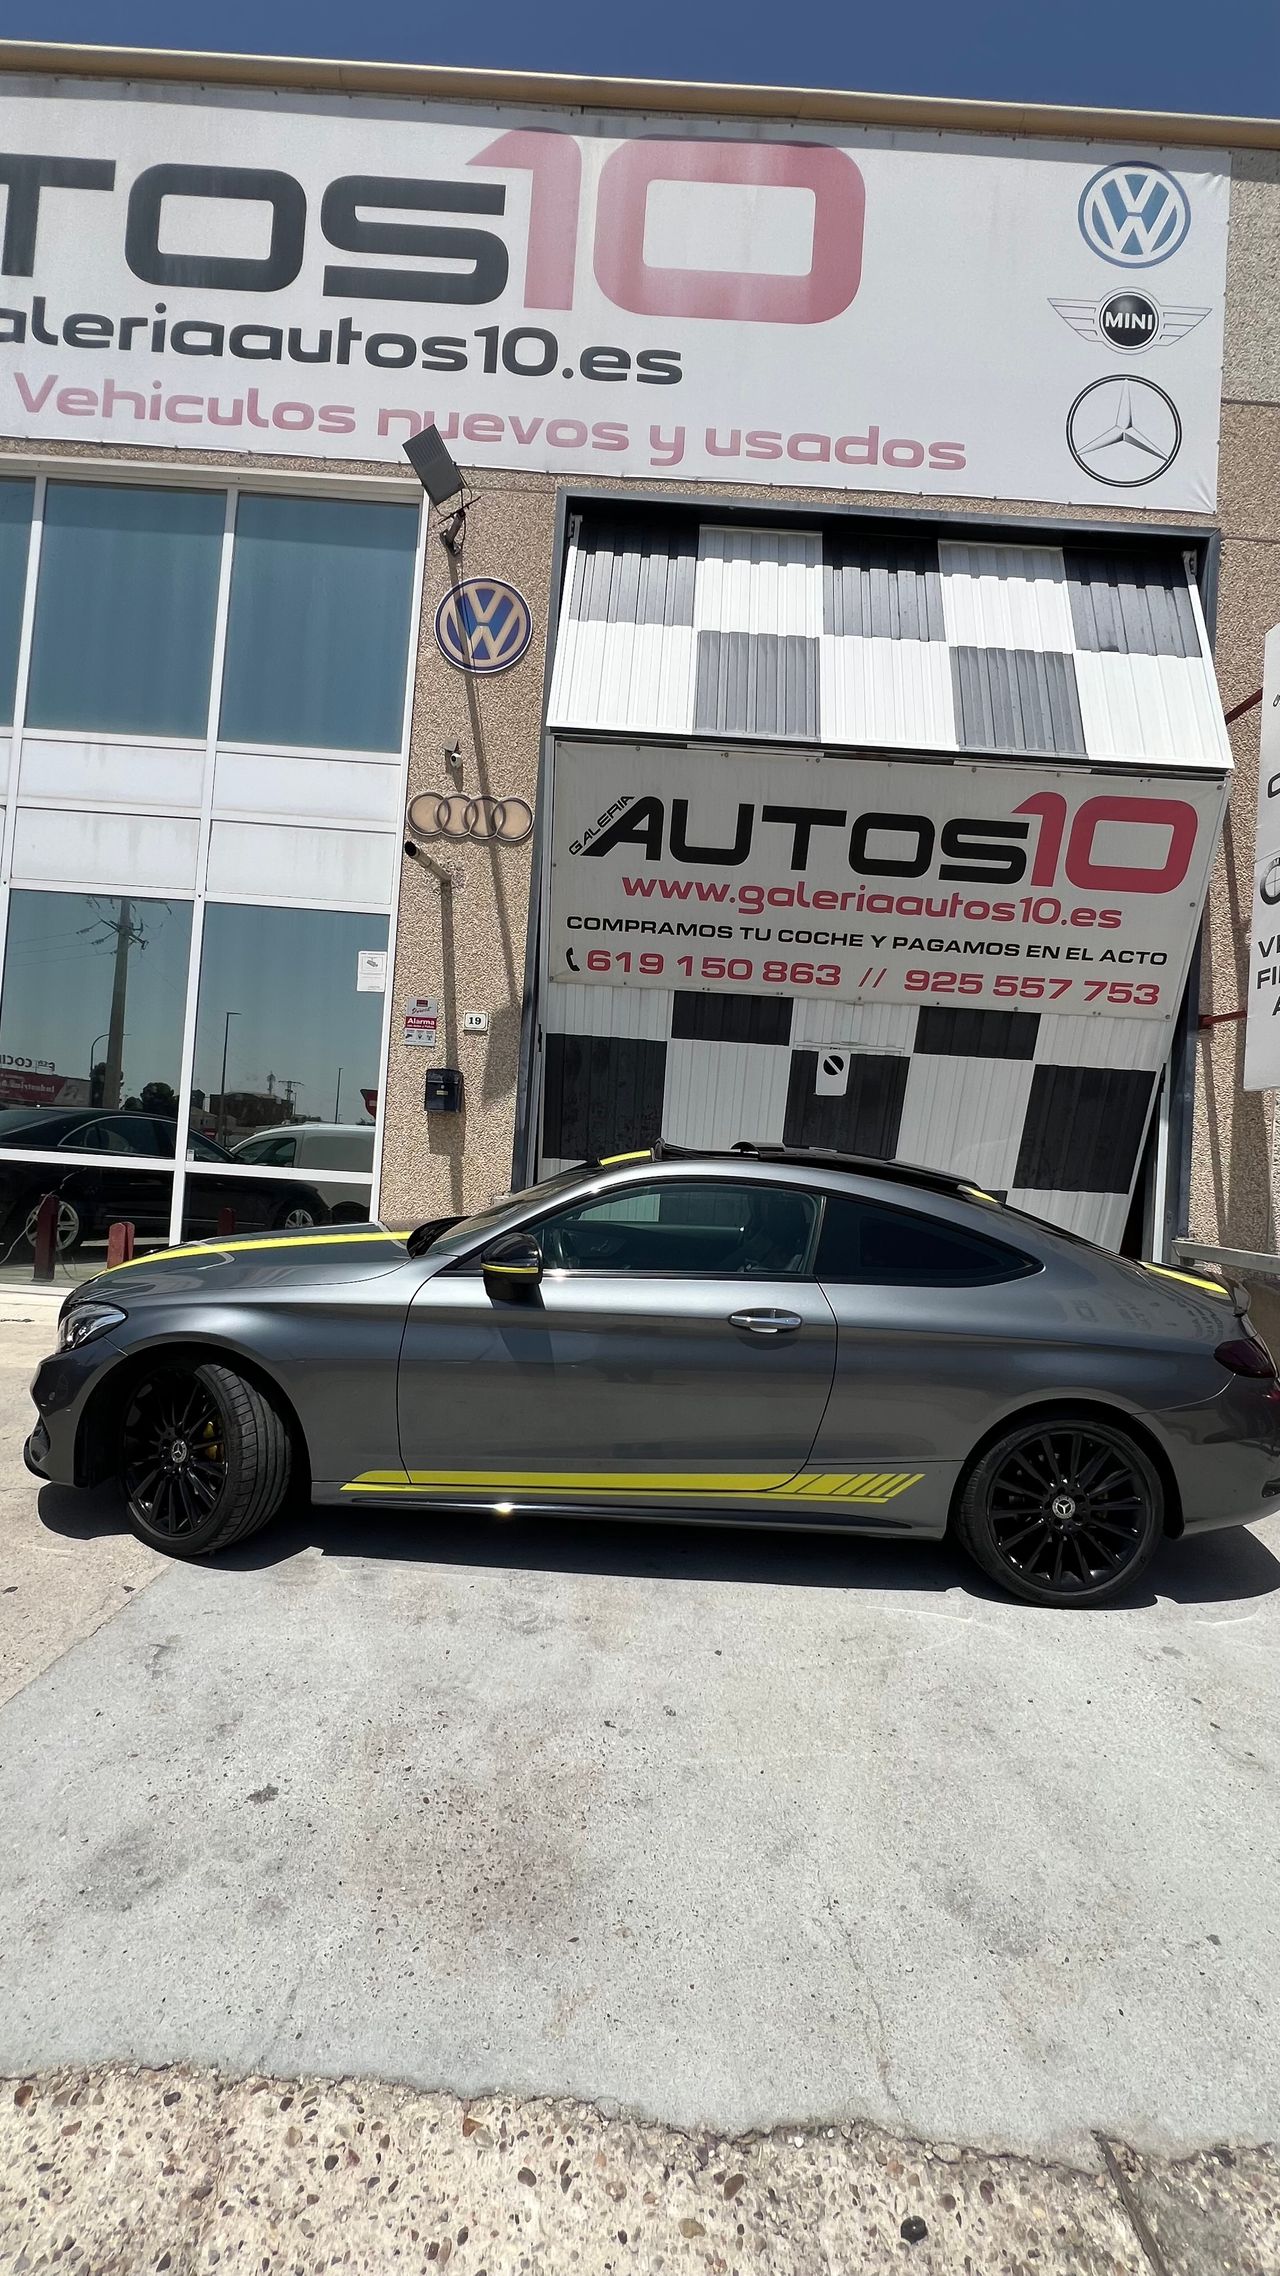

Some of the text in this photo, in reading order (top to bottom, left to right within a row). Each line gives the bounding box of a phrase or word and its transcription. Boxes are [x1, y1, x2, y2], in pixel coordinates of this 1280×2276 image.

[1105, 311, 1153, 330] MINI
[14, 371, 967, 471] Vehiculos nuevos y usados
[568, 795, 636, 856] GALERIA
[580, 791, 1199, 894] AUTOS10
[621, 876, 1122, 929] www.galeriaautos10.es
[566, 915, 1168, 966] COMPRAMOS TU COCHE Y PAGAMOS EN EL ACTO
[586, 949, 665, 975] 619
[676, 955, 753, 981] 150
[762, 961, 842, 986] 863
[904, 969, 984, 995] 925
[992, 974, 1073, 1000] 557
[1083, 980, 1160, 1005] 753
[407, 1017, 436, 1026] Alarma
[468, 1016, 482, 1025] 19
